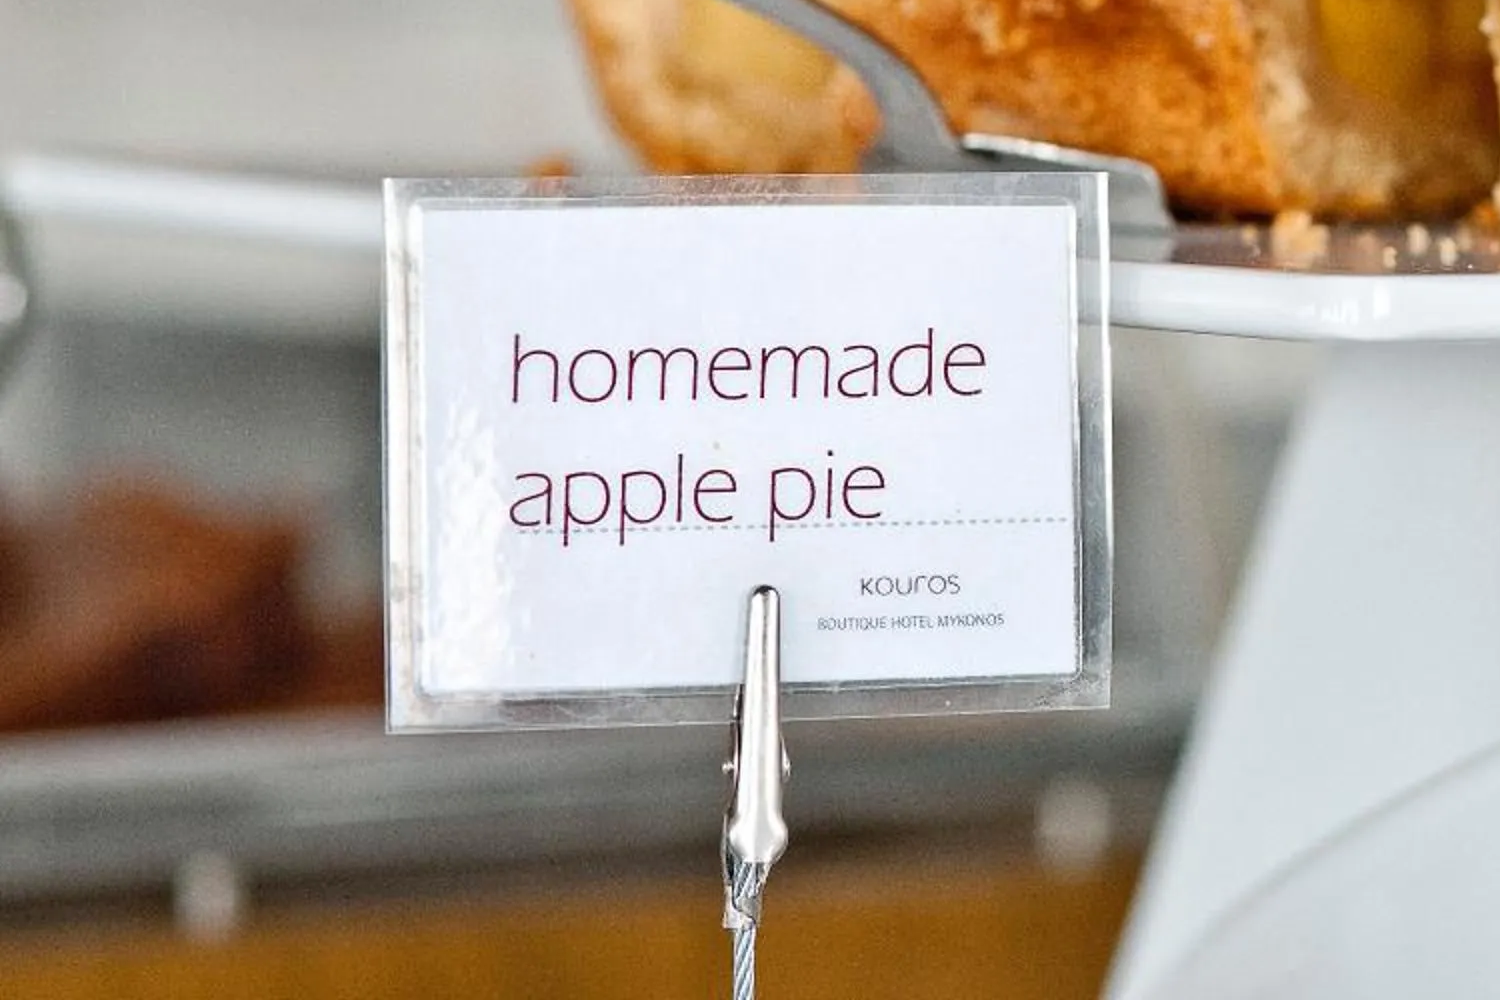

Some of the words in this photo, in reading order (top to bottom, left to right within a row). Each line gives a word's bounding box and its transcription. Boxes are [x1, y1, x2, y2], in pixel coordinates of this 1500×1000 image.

[511, 327, 987, 404] homemade
[508, 453, 738, 547] apple
[768, 449, 886, 543] pie
[817, 616, 888, 631] BOUTIQUE
[891, 615, 934, 629] HOTEL
[936, 612, 1005, 628] MYKONOS
